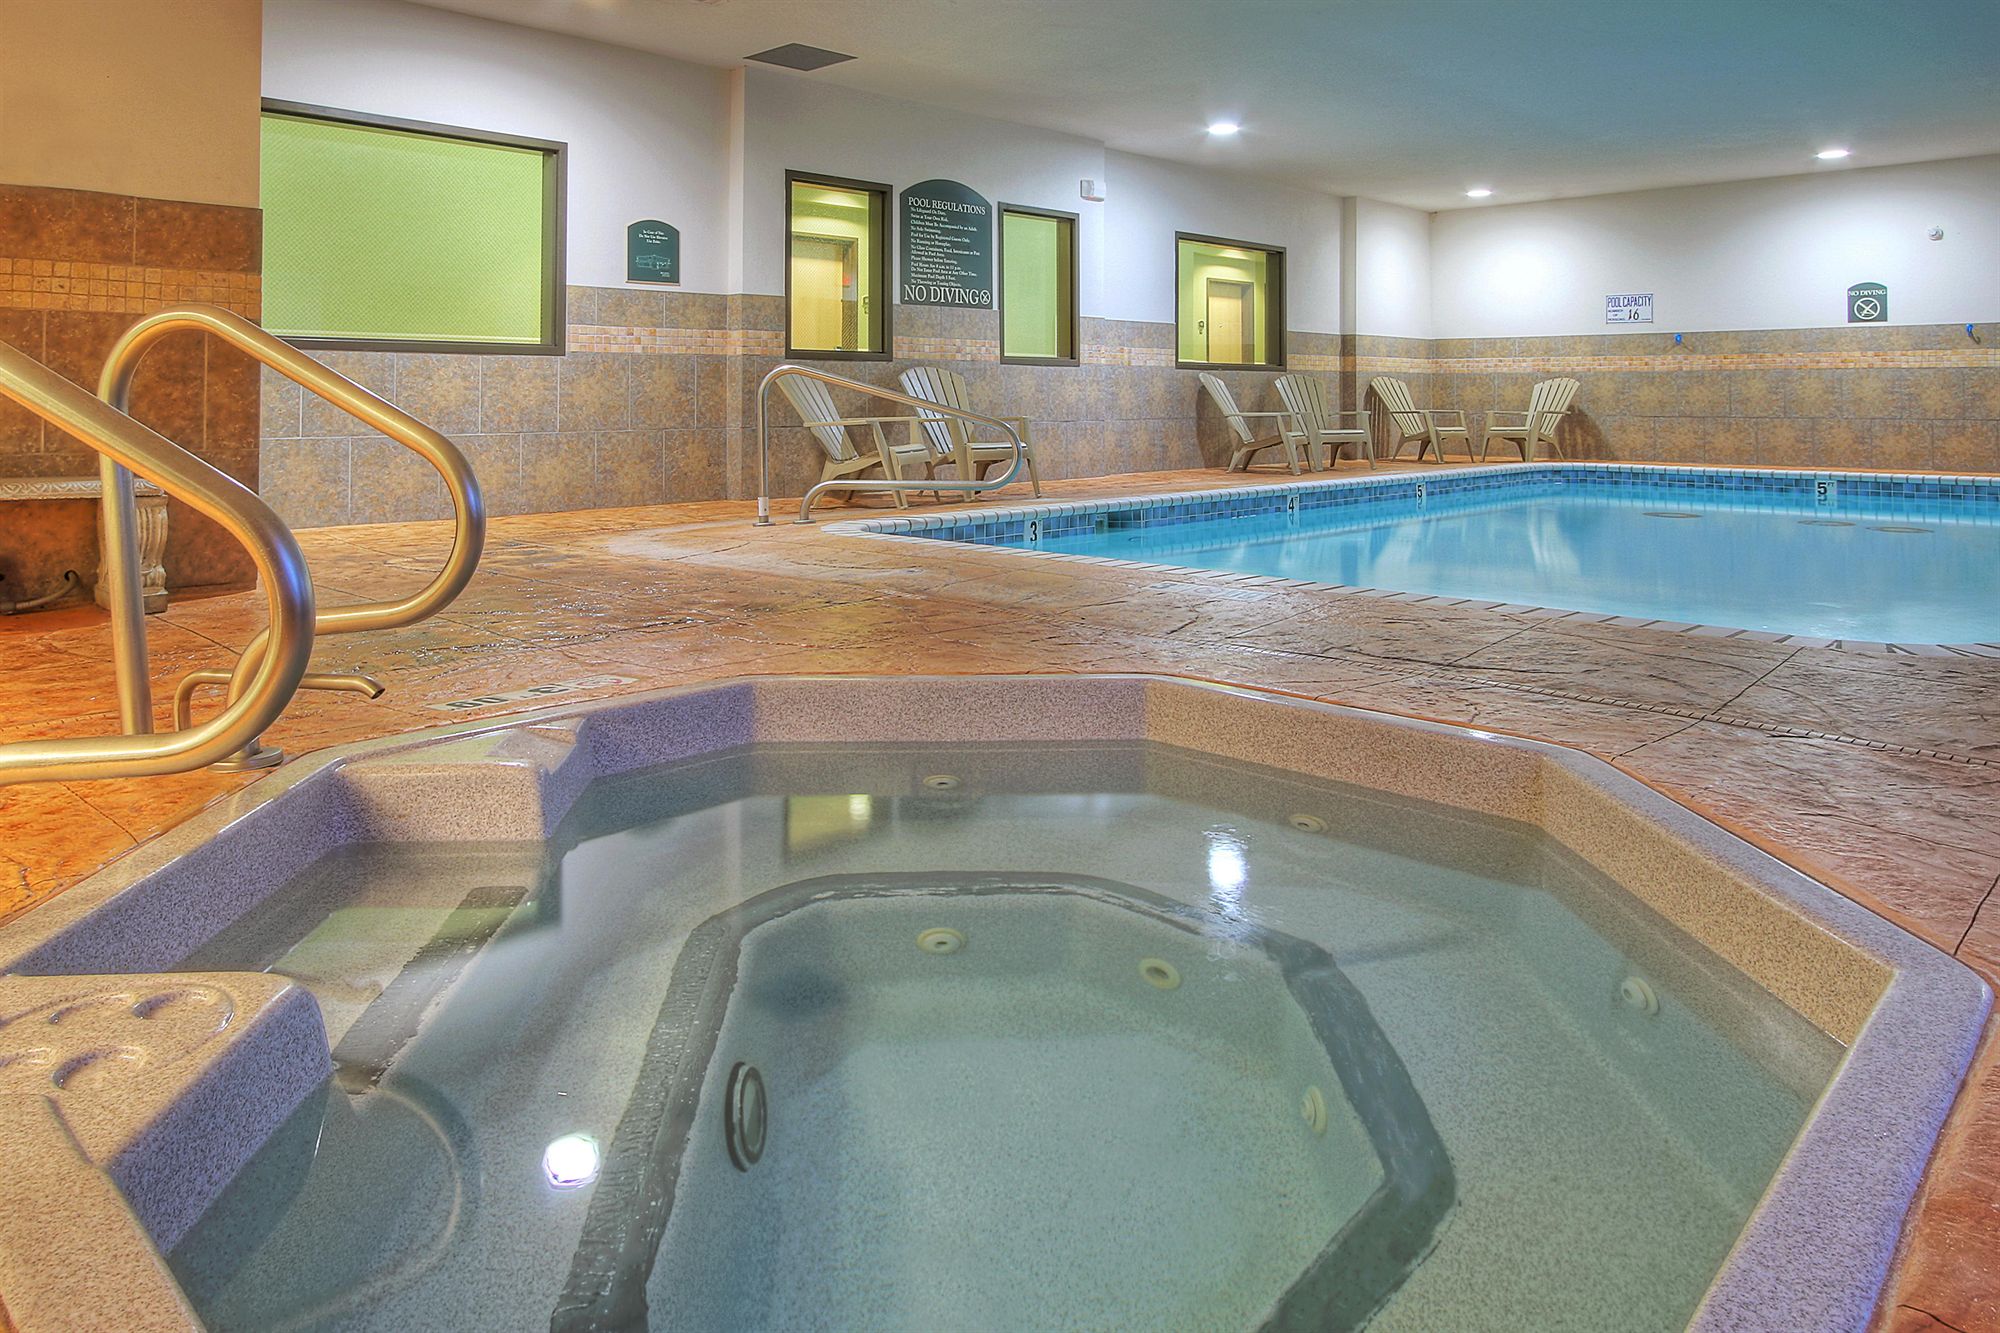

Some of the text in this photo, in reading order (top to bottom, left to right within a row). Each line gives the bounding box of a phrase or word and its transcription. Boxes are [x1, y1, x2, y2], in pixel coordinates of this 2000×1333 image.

[909, 197, 985, 215] POOL REGULATIONS
[904, 285, 979, 304] NO DIVING
[1608, 296, 1651, 307] POOL CAPACITY
[1628, 308, 1639, 320] 16
[1418, 484, 1422, 497] 5
[1817, 482, 1827, 495] 5
[1289, 497, 1294, 512] 4
[1030, 520, 1037, 542] 3
